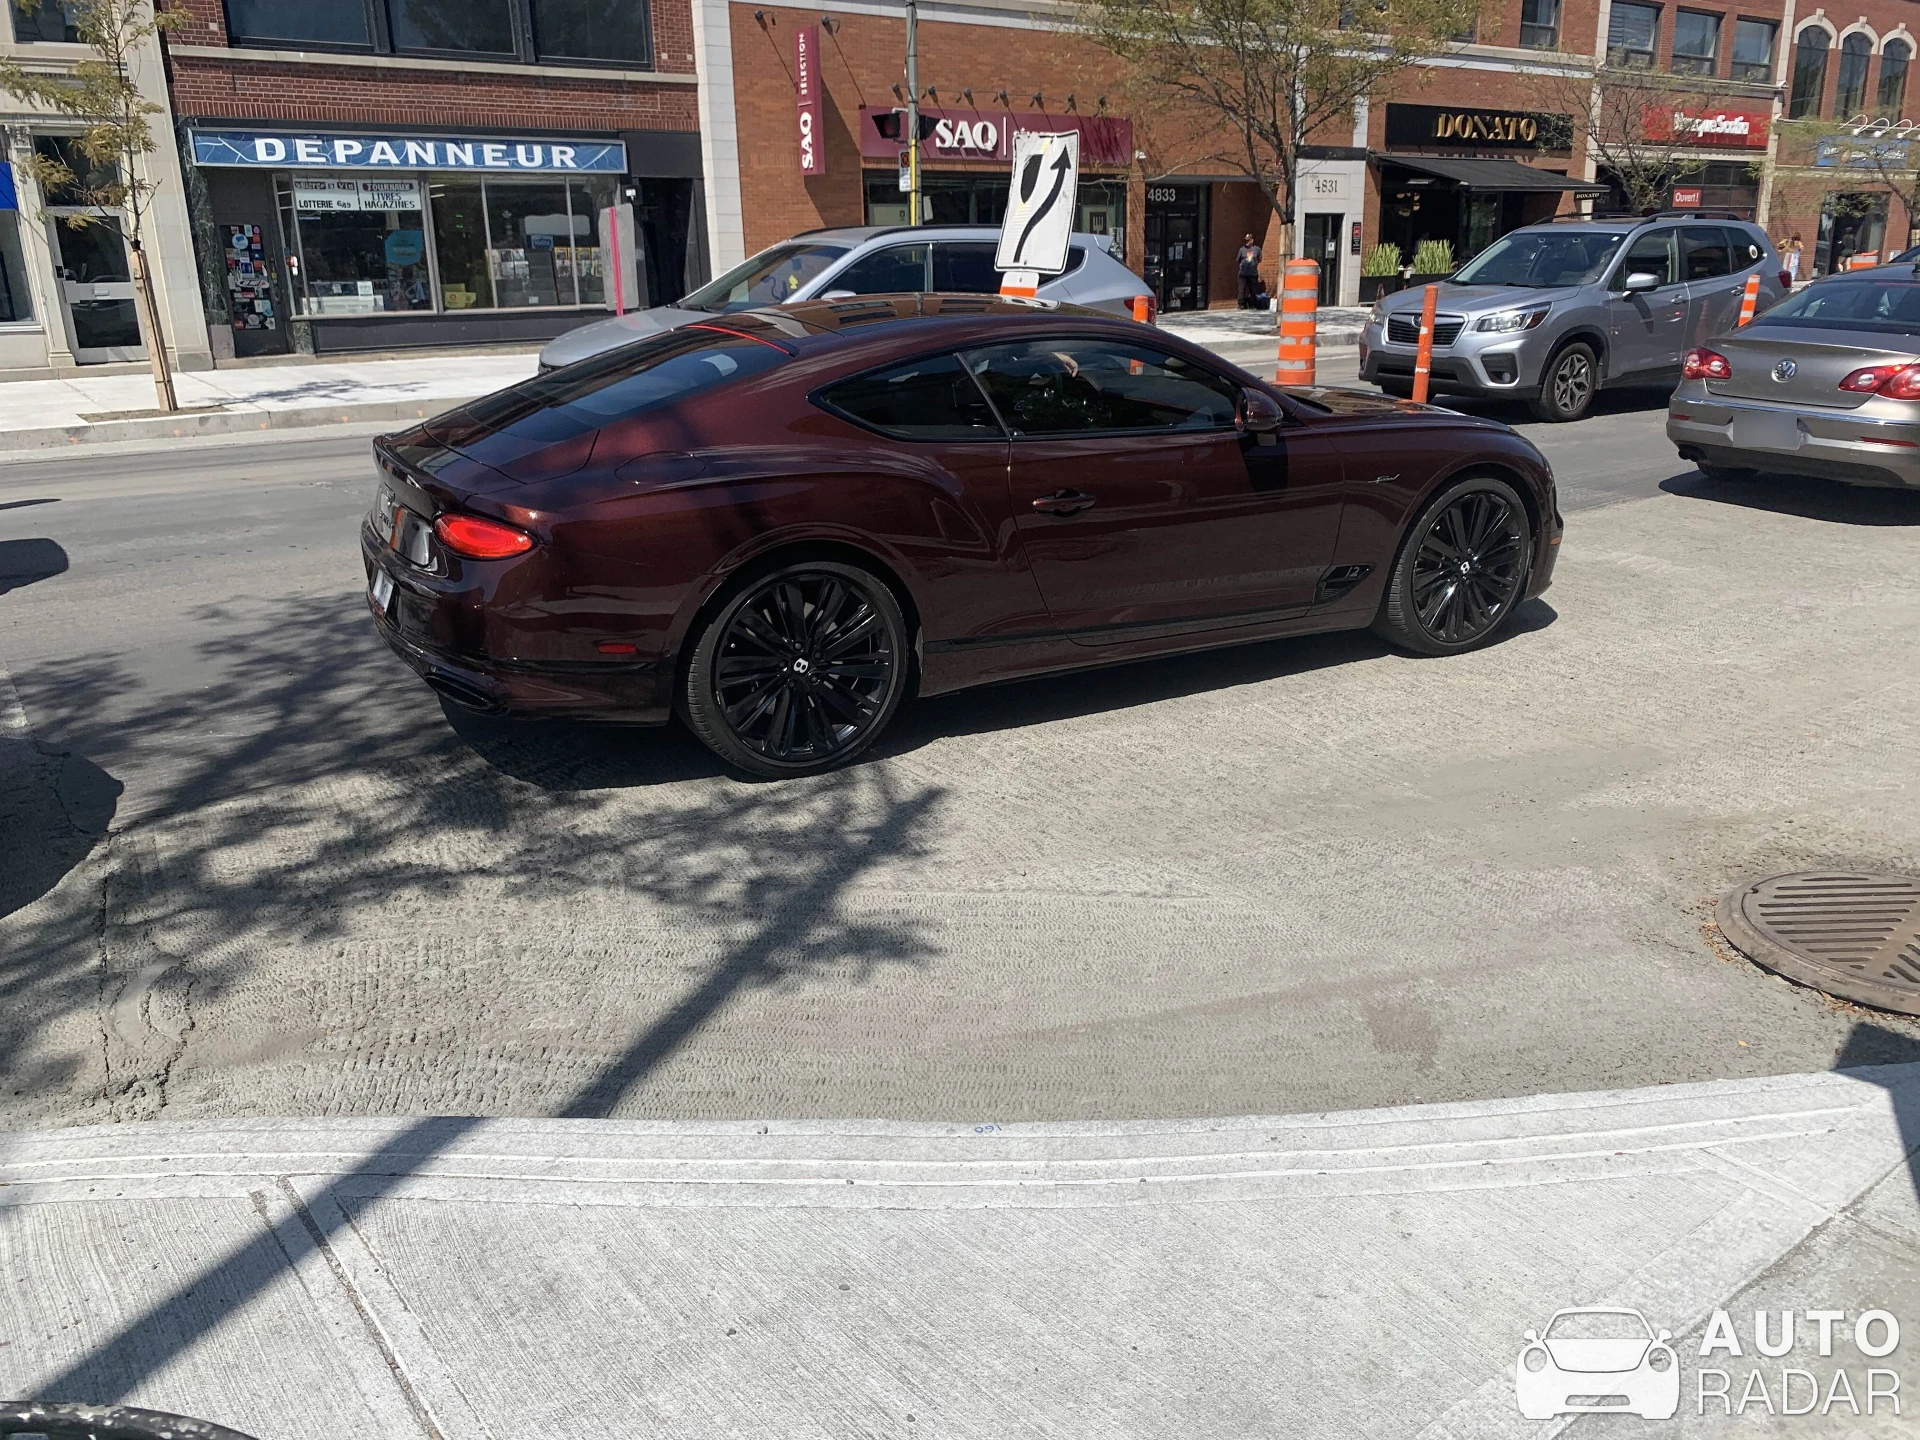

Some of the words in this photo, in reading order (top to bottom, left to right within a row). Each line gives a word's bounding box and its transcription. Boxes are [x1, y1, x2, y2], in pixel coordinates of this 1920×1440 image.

[1436, 113, 1537, 141] DONATO
[800, 111, 814, 169] SAQ
[935, 118, 998, 151] SAQ
[1314, 179, 1338, 193] 4831
[371, 192, 402, 201] LIVRES
[1147, 188, 1176, 201] 4833
[299, 200, 333, 208] LOTTERIE
[364, 200, 415, 209] MAGAZINES
